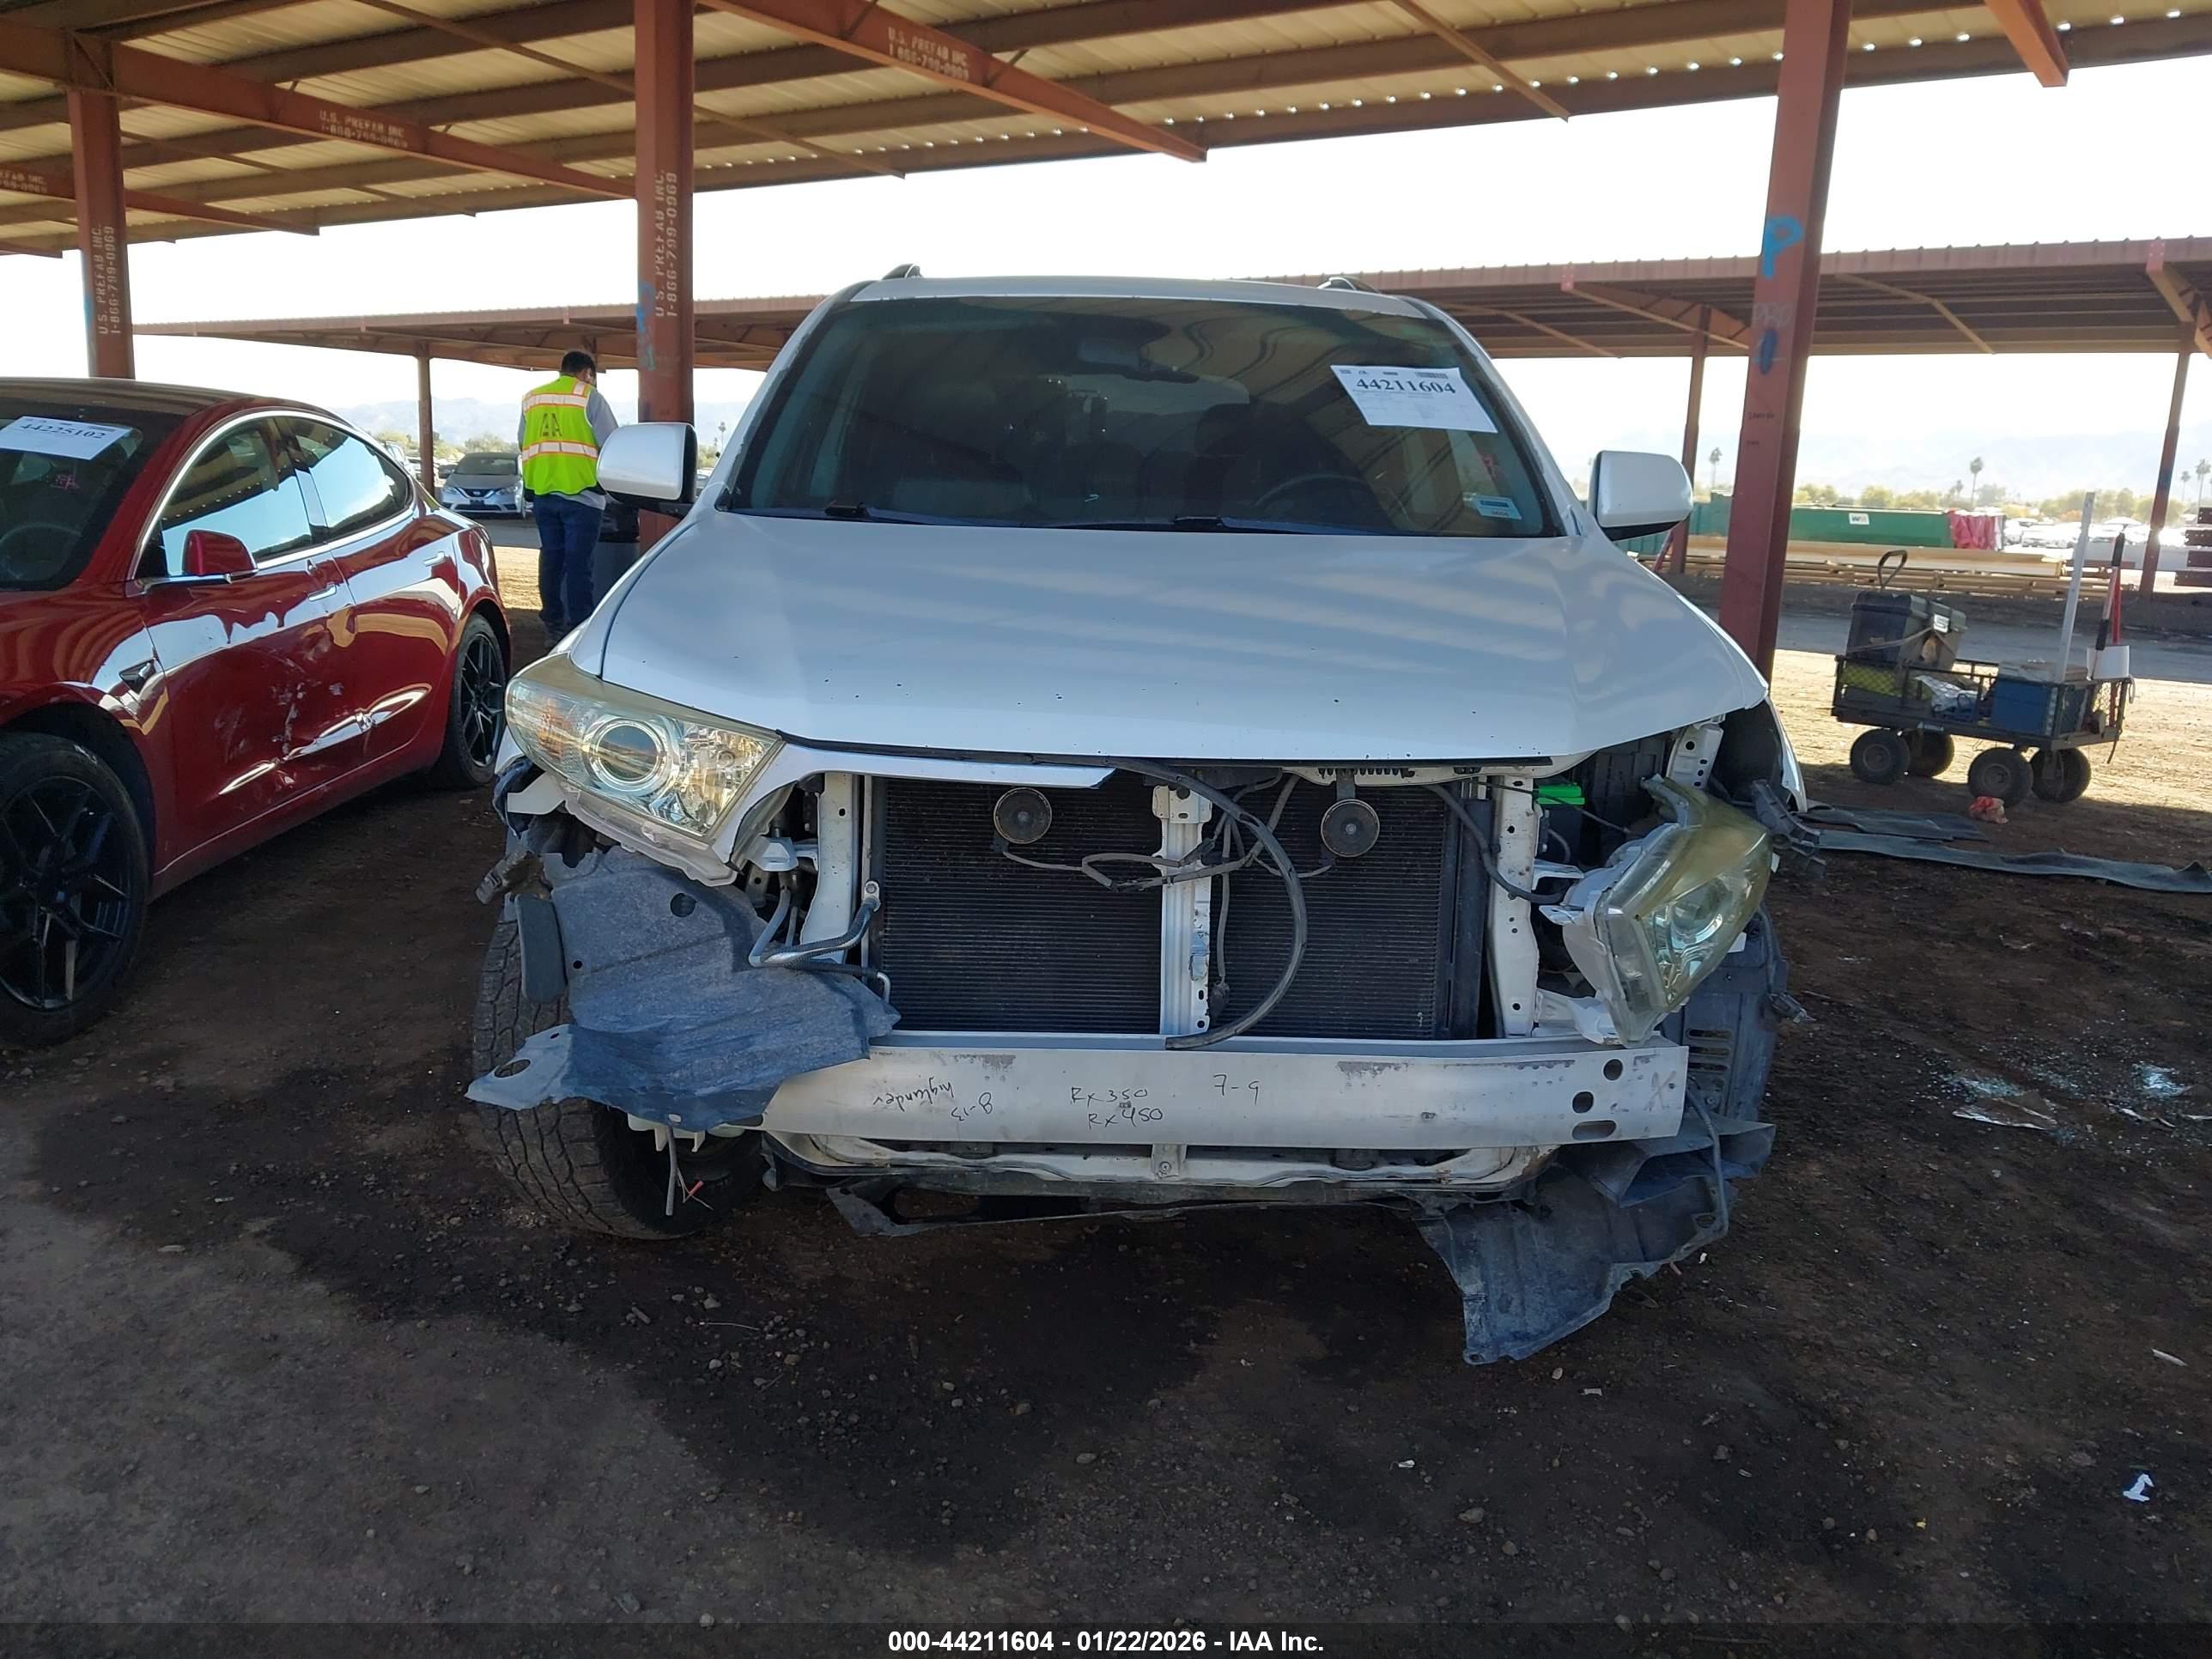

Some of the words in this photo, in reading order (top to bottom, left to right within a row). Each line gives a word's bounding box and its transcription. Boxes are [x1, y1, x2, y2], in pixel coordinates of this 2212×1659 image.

[655, 210, 665, 276] PREFAB
[665, 173, 678, 317] 1-866-799-0969
[1762, 216, 1803, 279] P
[93, 254, 106, 303] PREFAB
[103, 226, 121, 334] 1-866-799-0969
[1356, 378, 1456, 394] 44211604
[21, 423, 106, 439] 44225102
